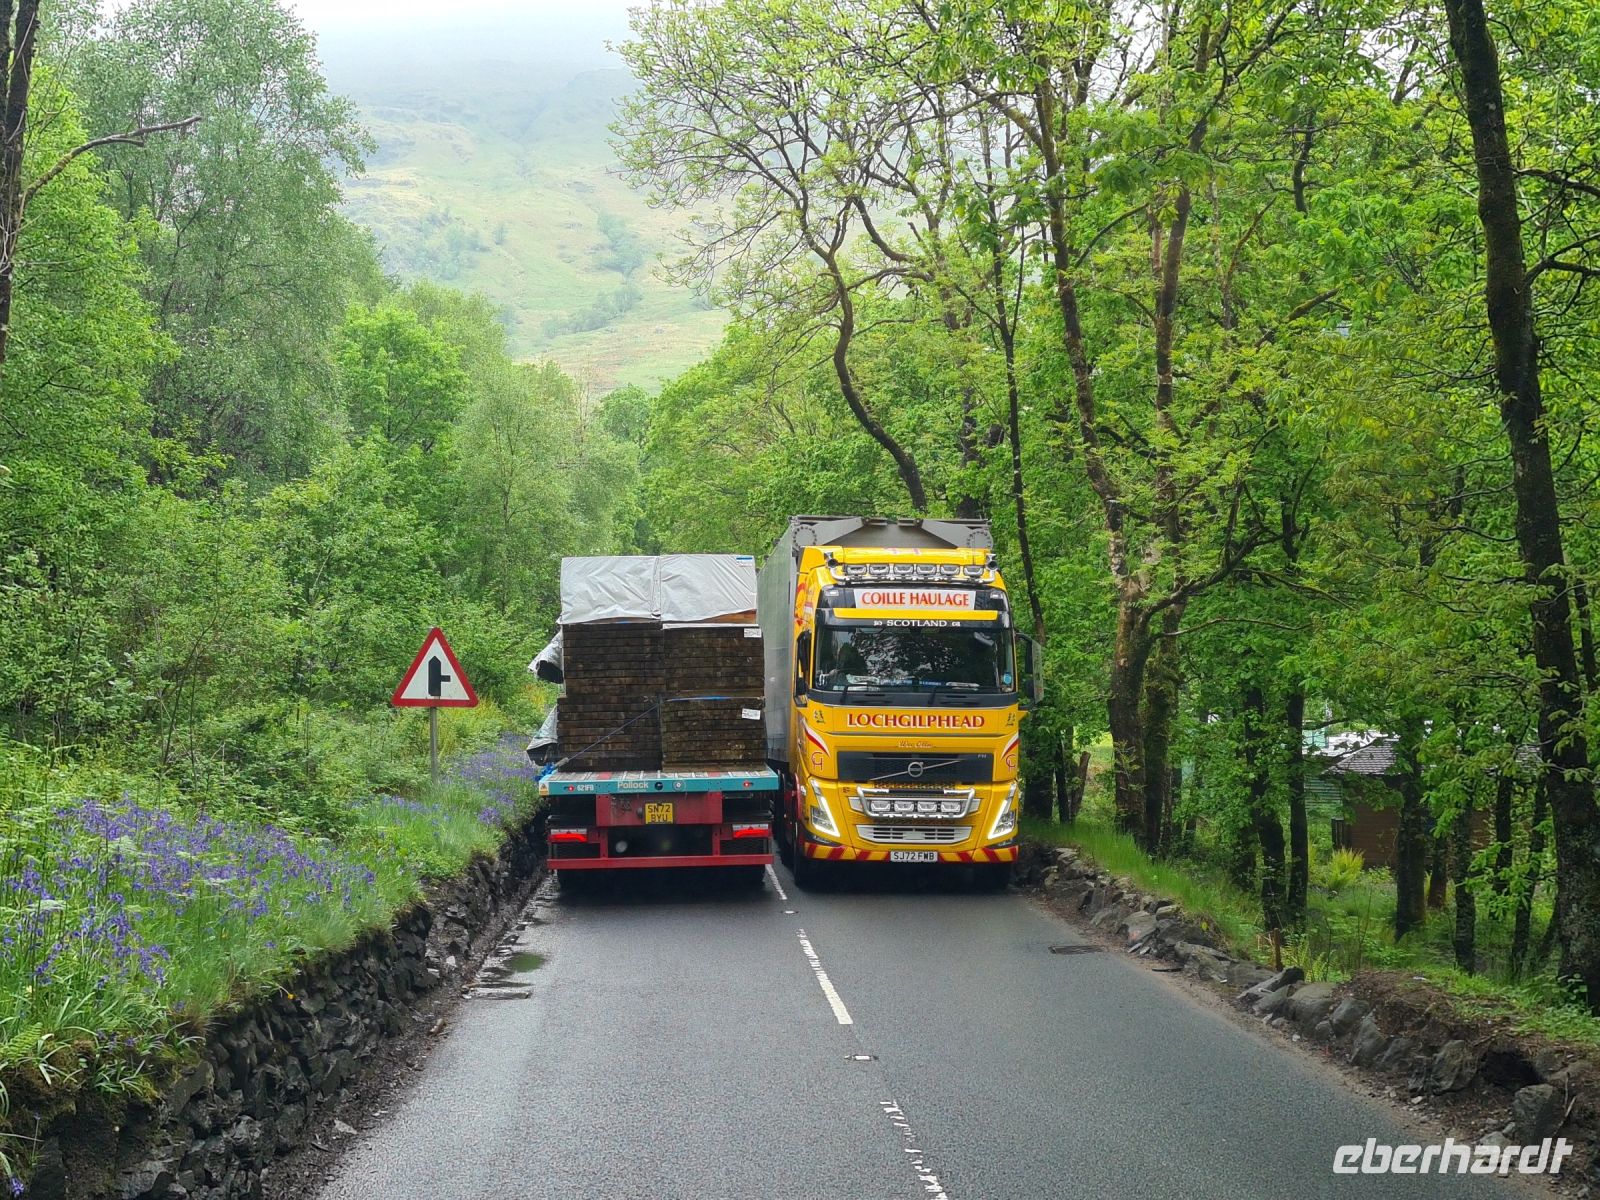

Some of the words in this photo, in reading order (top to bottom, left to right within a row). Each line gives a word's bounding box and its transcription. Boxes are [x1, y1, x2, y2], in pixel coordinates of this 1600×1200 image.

[861, 592, 906, 605] COILLE
[909, 592, 969, 607] HAULAGE
[886, 619, 948, 627] SCOTLAND
[846, 713, 985, 729] LOCHGILPHEAD
[617, 781, 649, 789] Pollock
[647, 804, 671, 813] SN72
[650, 814, 668, 822] BYU
[893, 851, 916, 860] SJ72
[917, 852, 935, 860] FWB
